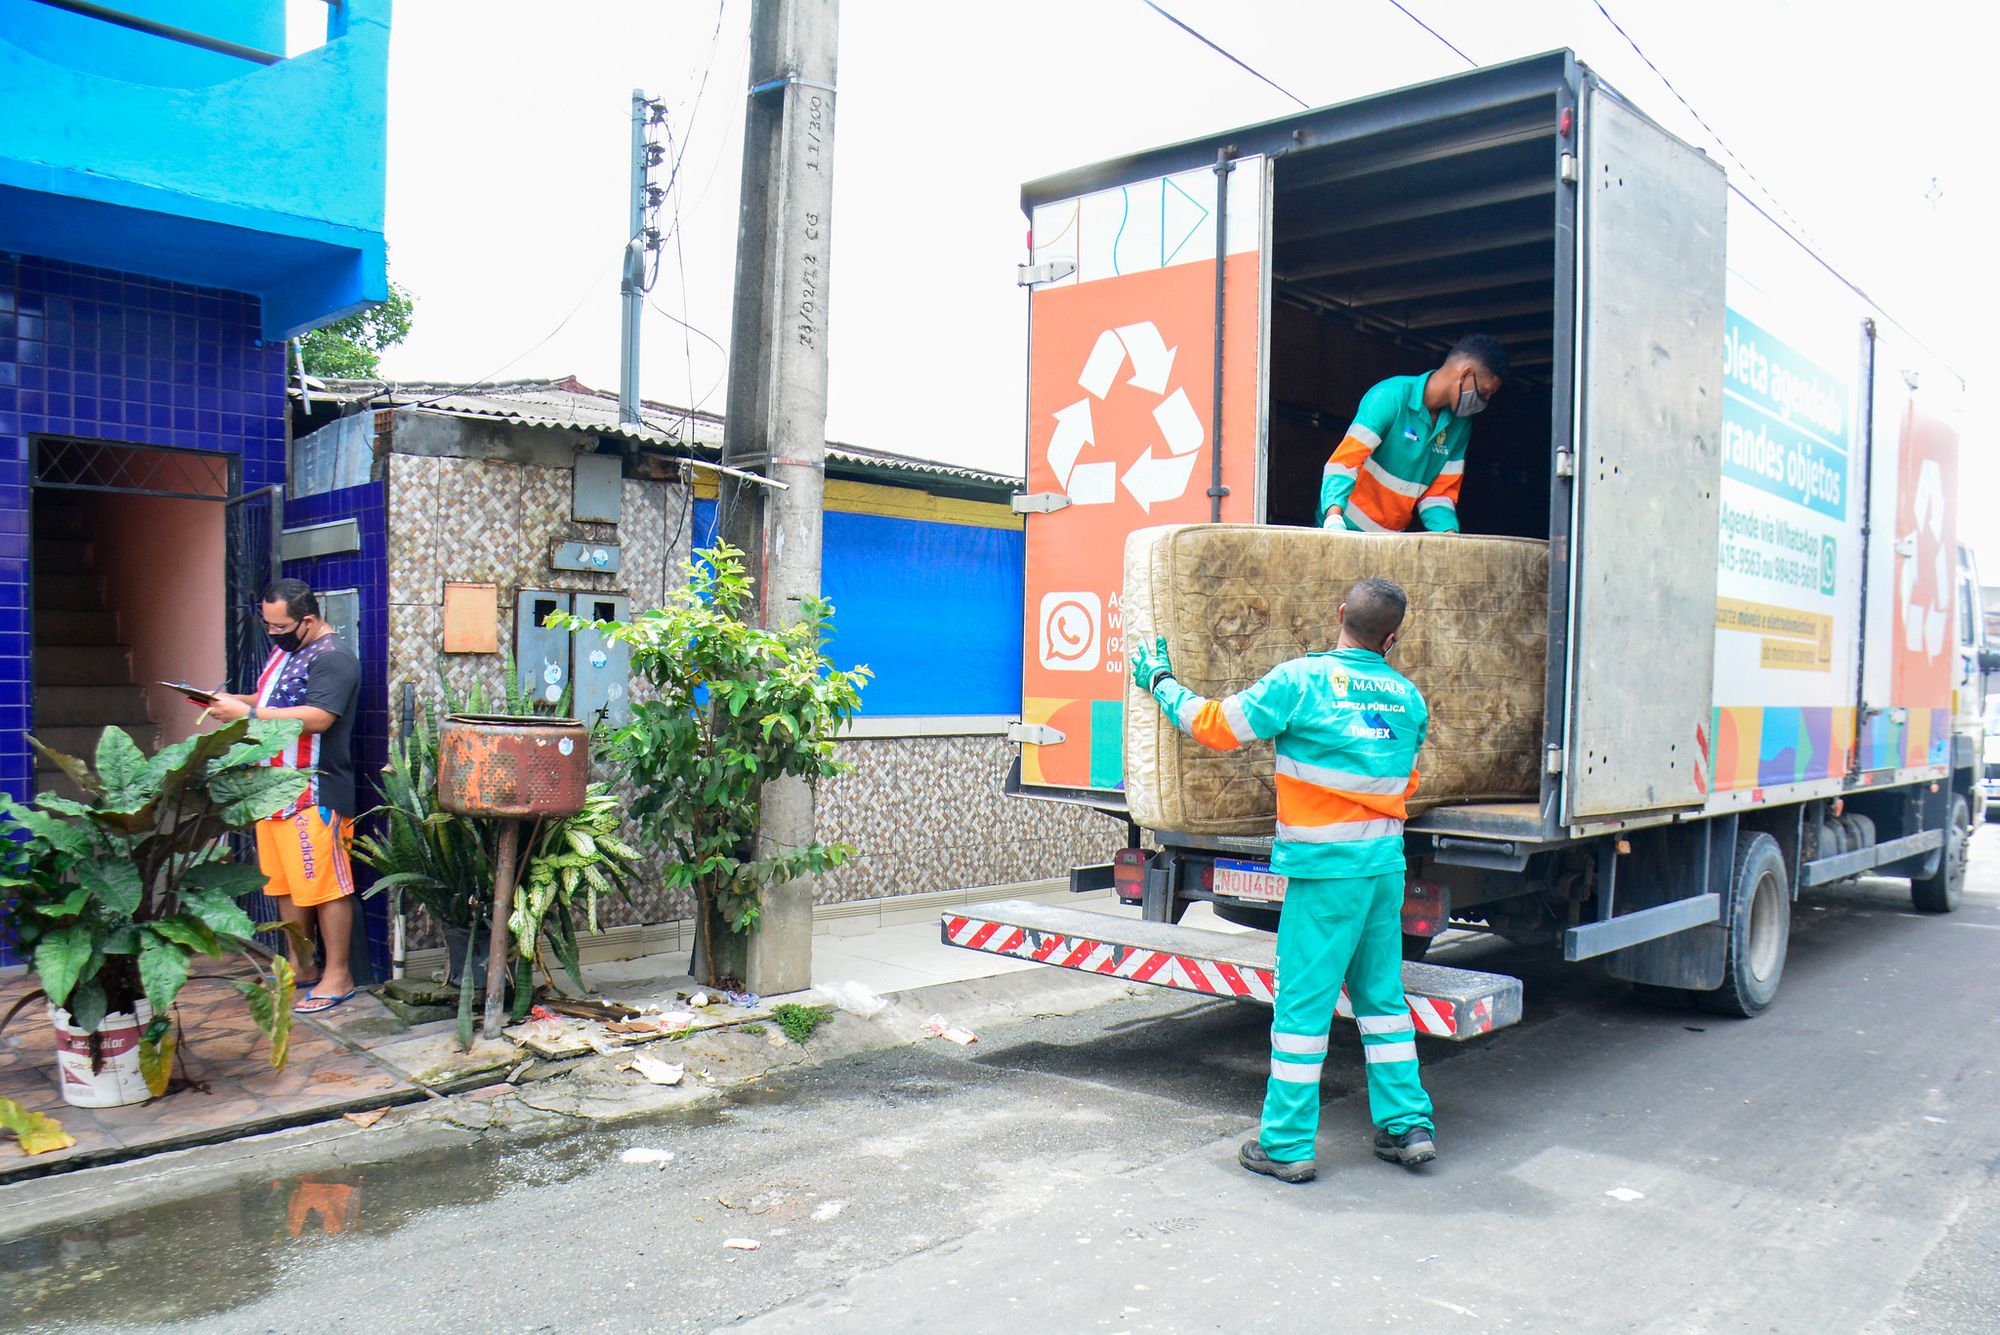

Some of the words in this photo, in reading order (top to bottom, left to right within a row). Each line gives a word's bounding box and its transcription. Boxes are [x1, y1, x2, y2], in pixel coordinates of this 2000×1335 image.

[1721, 418, 1785, 482] randes
[1787, 441, 1841, 506] objetos
[1720, 501, 1760, 541] Agende
[1761, 513, 1774, 545] via
[1776, 518, 1819, 562] WhatsApp
[1106, 661, 1123, 673] ou
[1352, 679, 1406, 695] MANAUS
[1368, 701, 1406, 713] PÚBLICA
[298, 829, 316, 879] adidas
